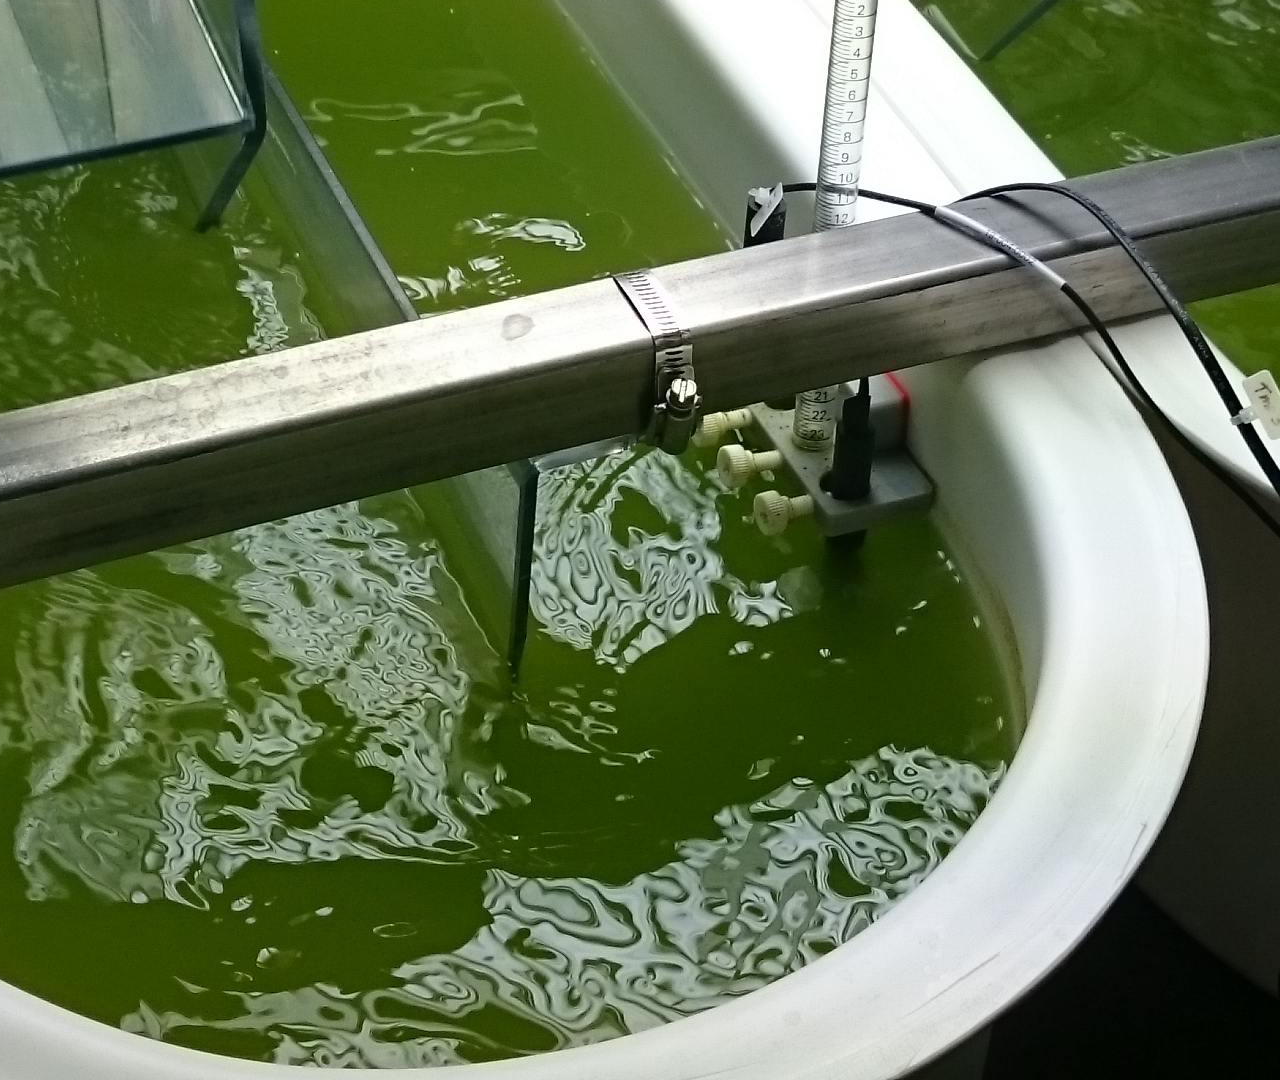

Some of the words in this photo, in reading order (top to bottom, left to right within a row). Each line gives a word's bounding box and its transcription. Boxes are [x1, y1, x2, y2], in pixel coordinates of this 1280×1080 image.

[857, 5, 865, 16] 2
[855, 26, 863, 37] 3
[853, 47, 861, 58] 4
[850, 69, 858, 80] 5
[848, 90, 856, 101] 6
[846, 111, 854, 122] 7
[843, 132, 852, 143] 8
[841, 152, 849, 163] 9
[839, 172, 853, 183] 10
[834, 213, 848, 224] 12
[813, 391, 828, 401] 21
[811, 410, 827, 420] 22
